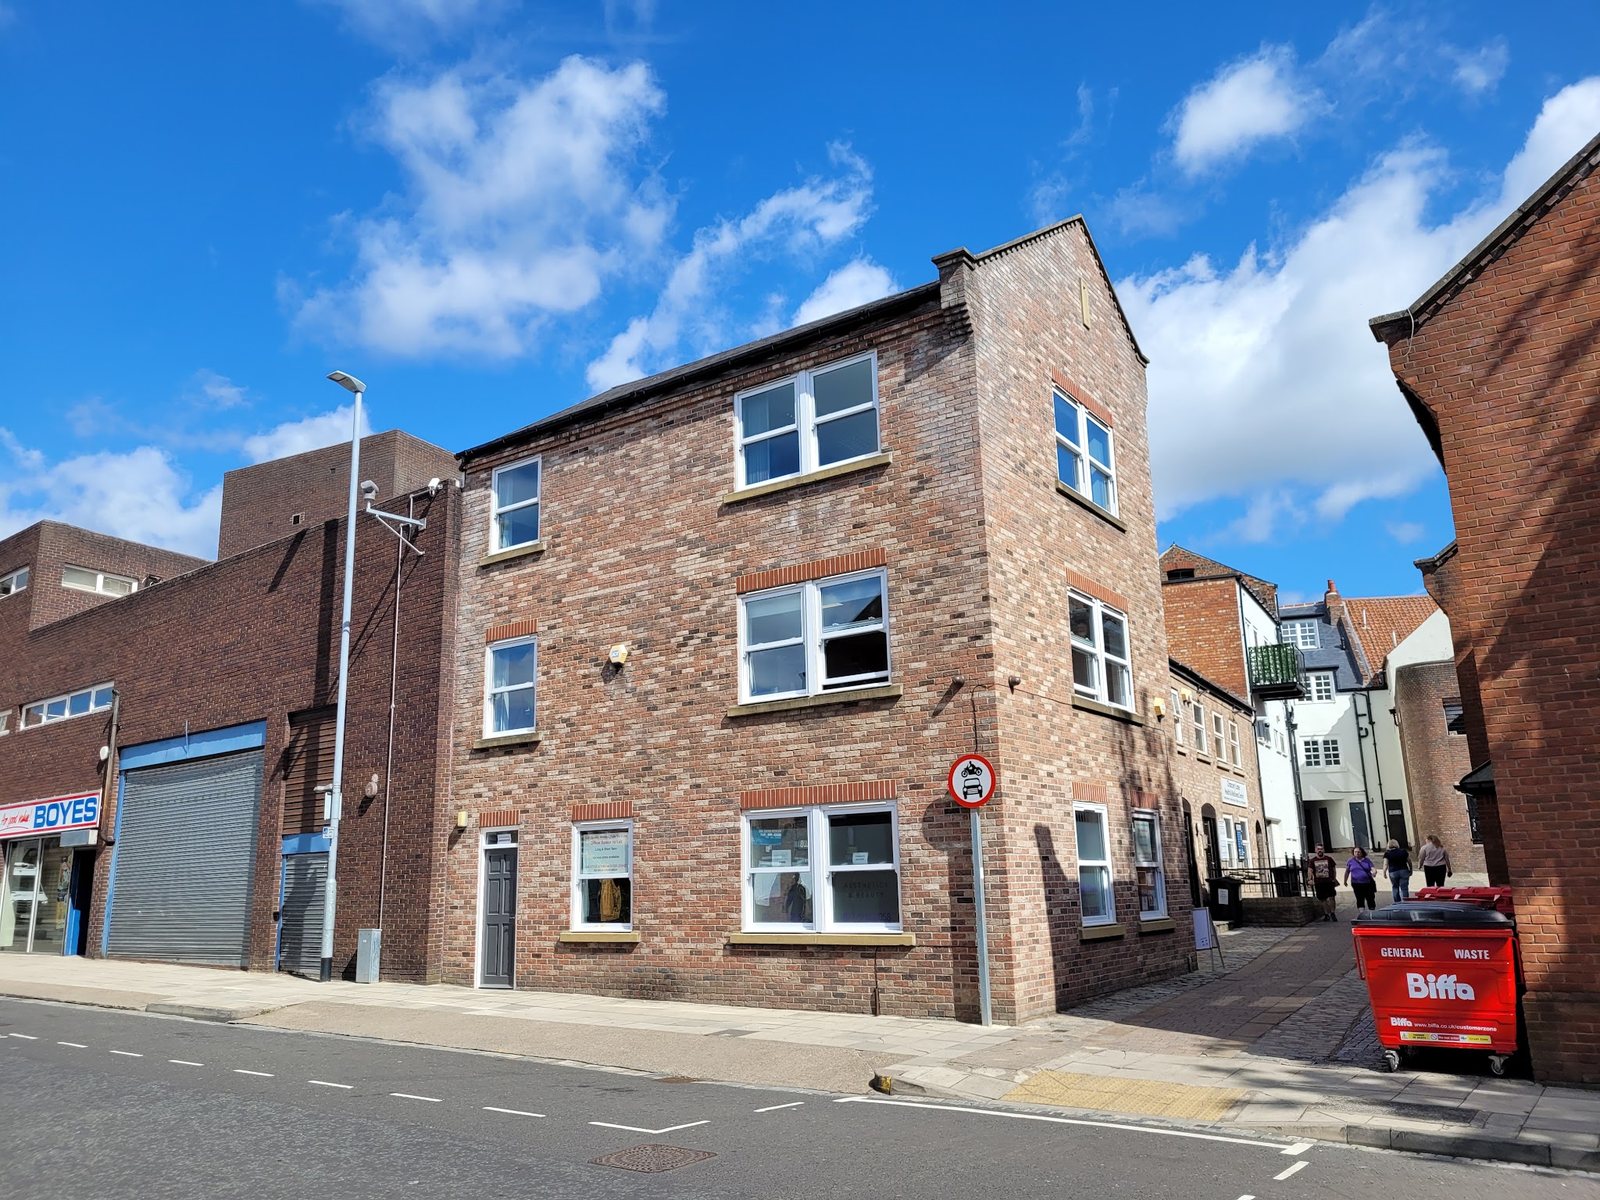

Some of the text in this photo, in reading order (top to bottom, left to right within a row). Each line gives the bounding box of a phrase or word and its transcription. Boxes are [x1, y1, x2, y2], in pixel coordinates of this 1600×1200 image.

[33, 797, 97, 828] BOYES
[1381, 948, 1490, 959] GENERAL WASTE
[1406, 973, 1475, 1000] Biffa
[1390, 1017, 1497, 1032] Biffa www.biffa.co.uk/customerzone
